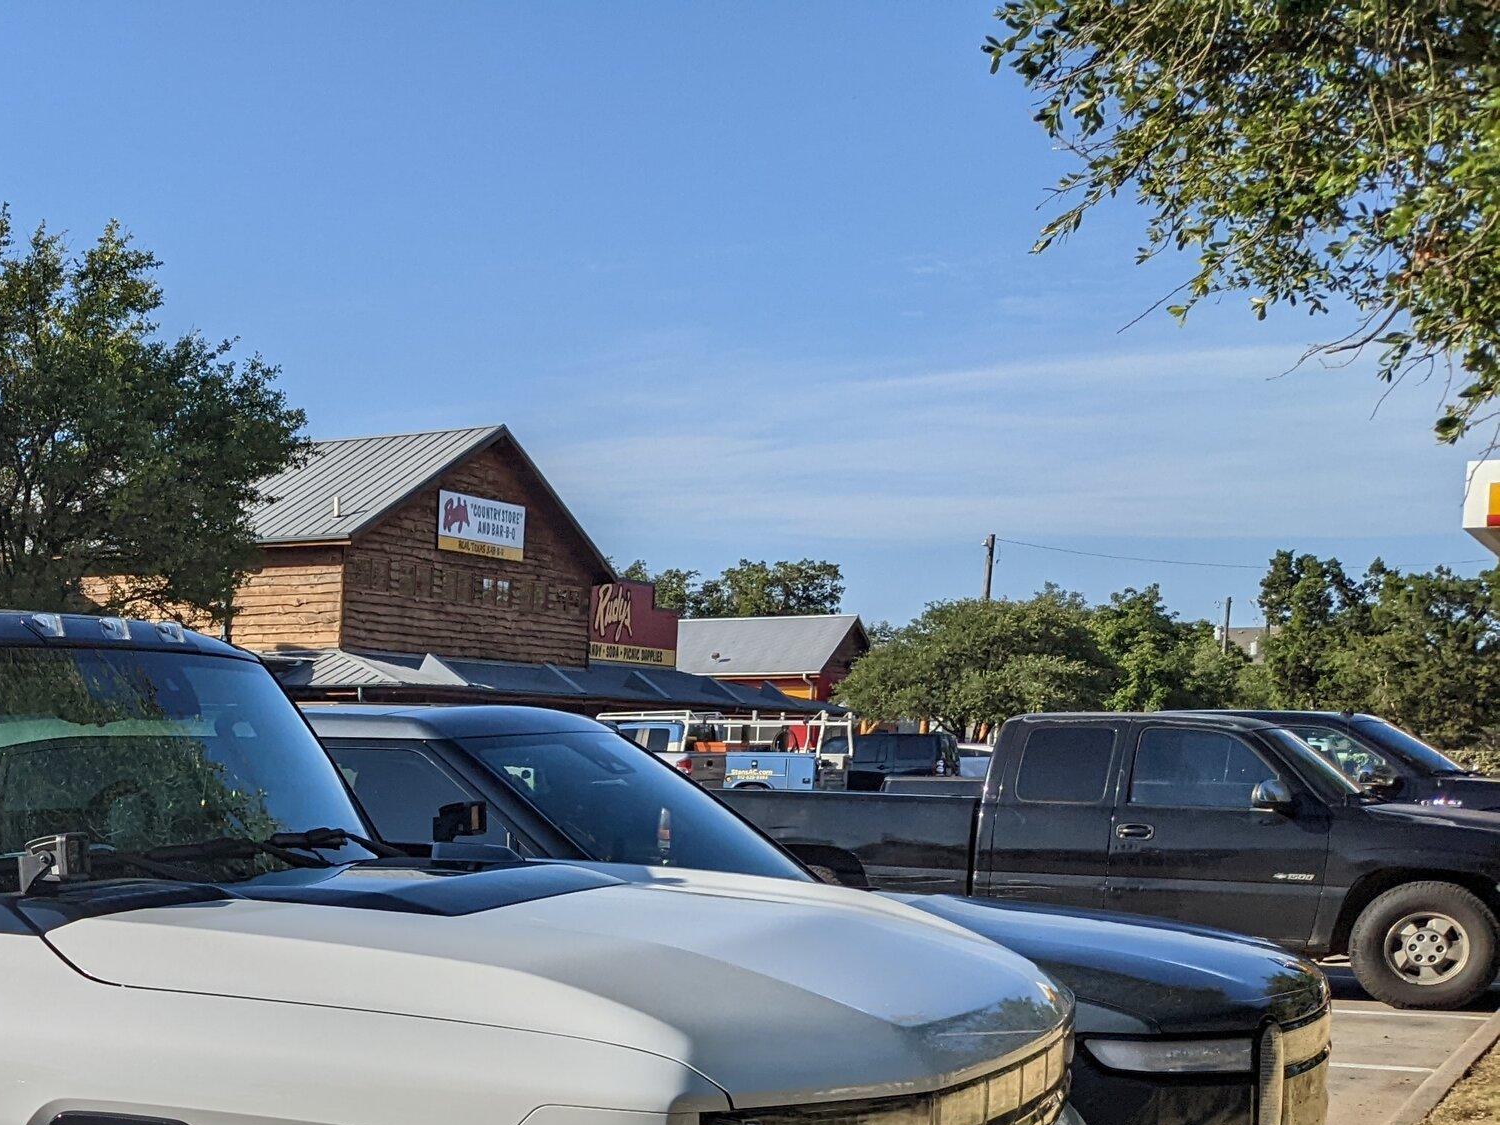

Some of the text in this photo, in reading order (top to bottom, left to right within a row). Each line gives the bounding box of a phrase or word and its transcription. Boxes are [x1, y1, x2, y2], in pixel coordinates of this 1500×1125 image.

[477, 521, 516, 540] AND BAR-B-Q
[594, 583, 632, 642] Rudy's
